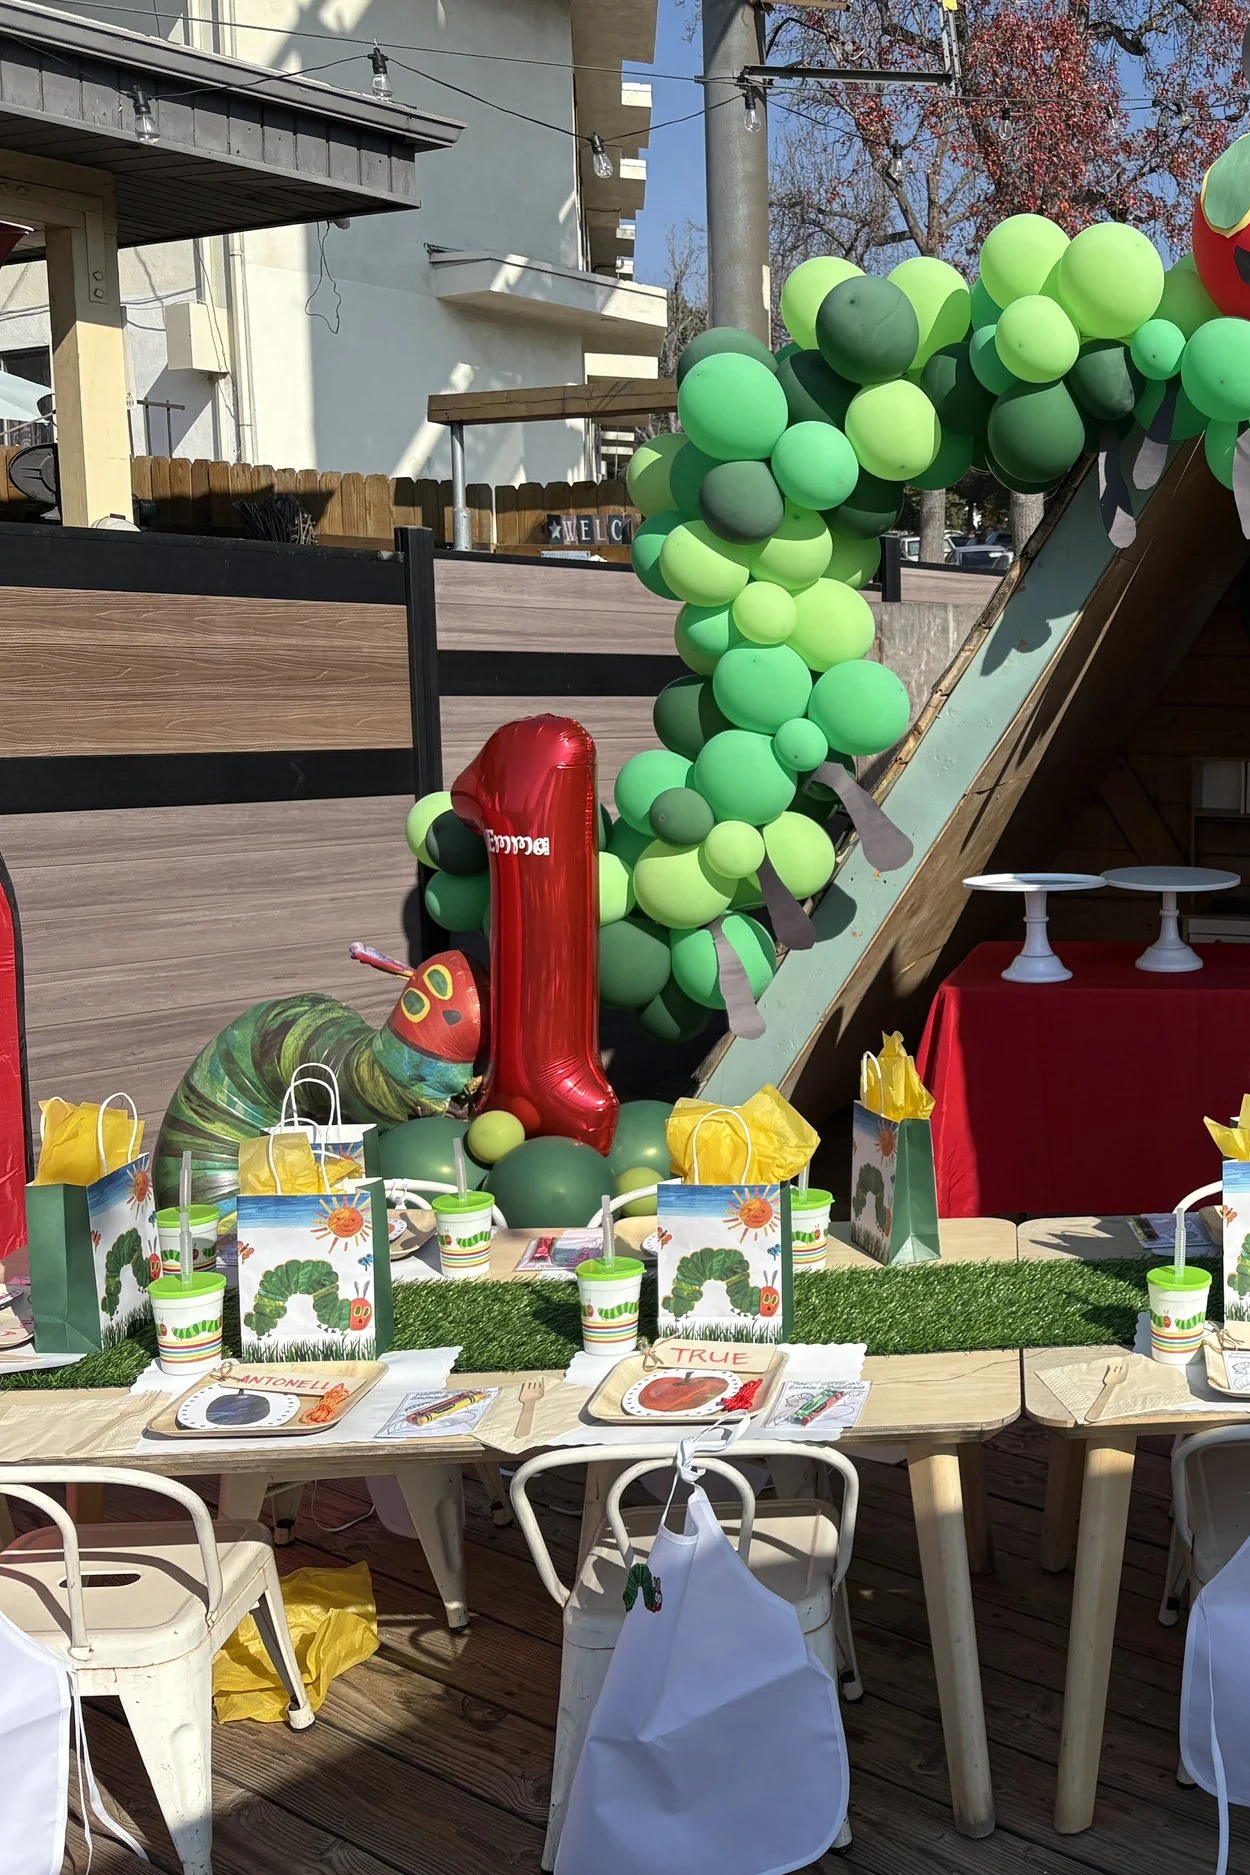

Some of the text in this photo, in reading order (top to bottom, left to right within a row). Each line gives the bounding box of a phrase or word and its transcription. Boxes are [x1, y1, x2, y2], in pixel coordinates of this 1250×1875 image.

[562, 519, 631, 541] WELC
[485, 829, 550, 856] Emma
[670, 1347, 752, 1365] TRUE
[239, 1374, 345, 1392] ANTONELLA
